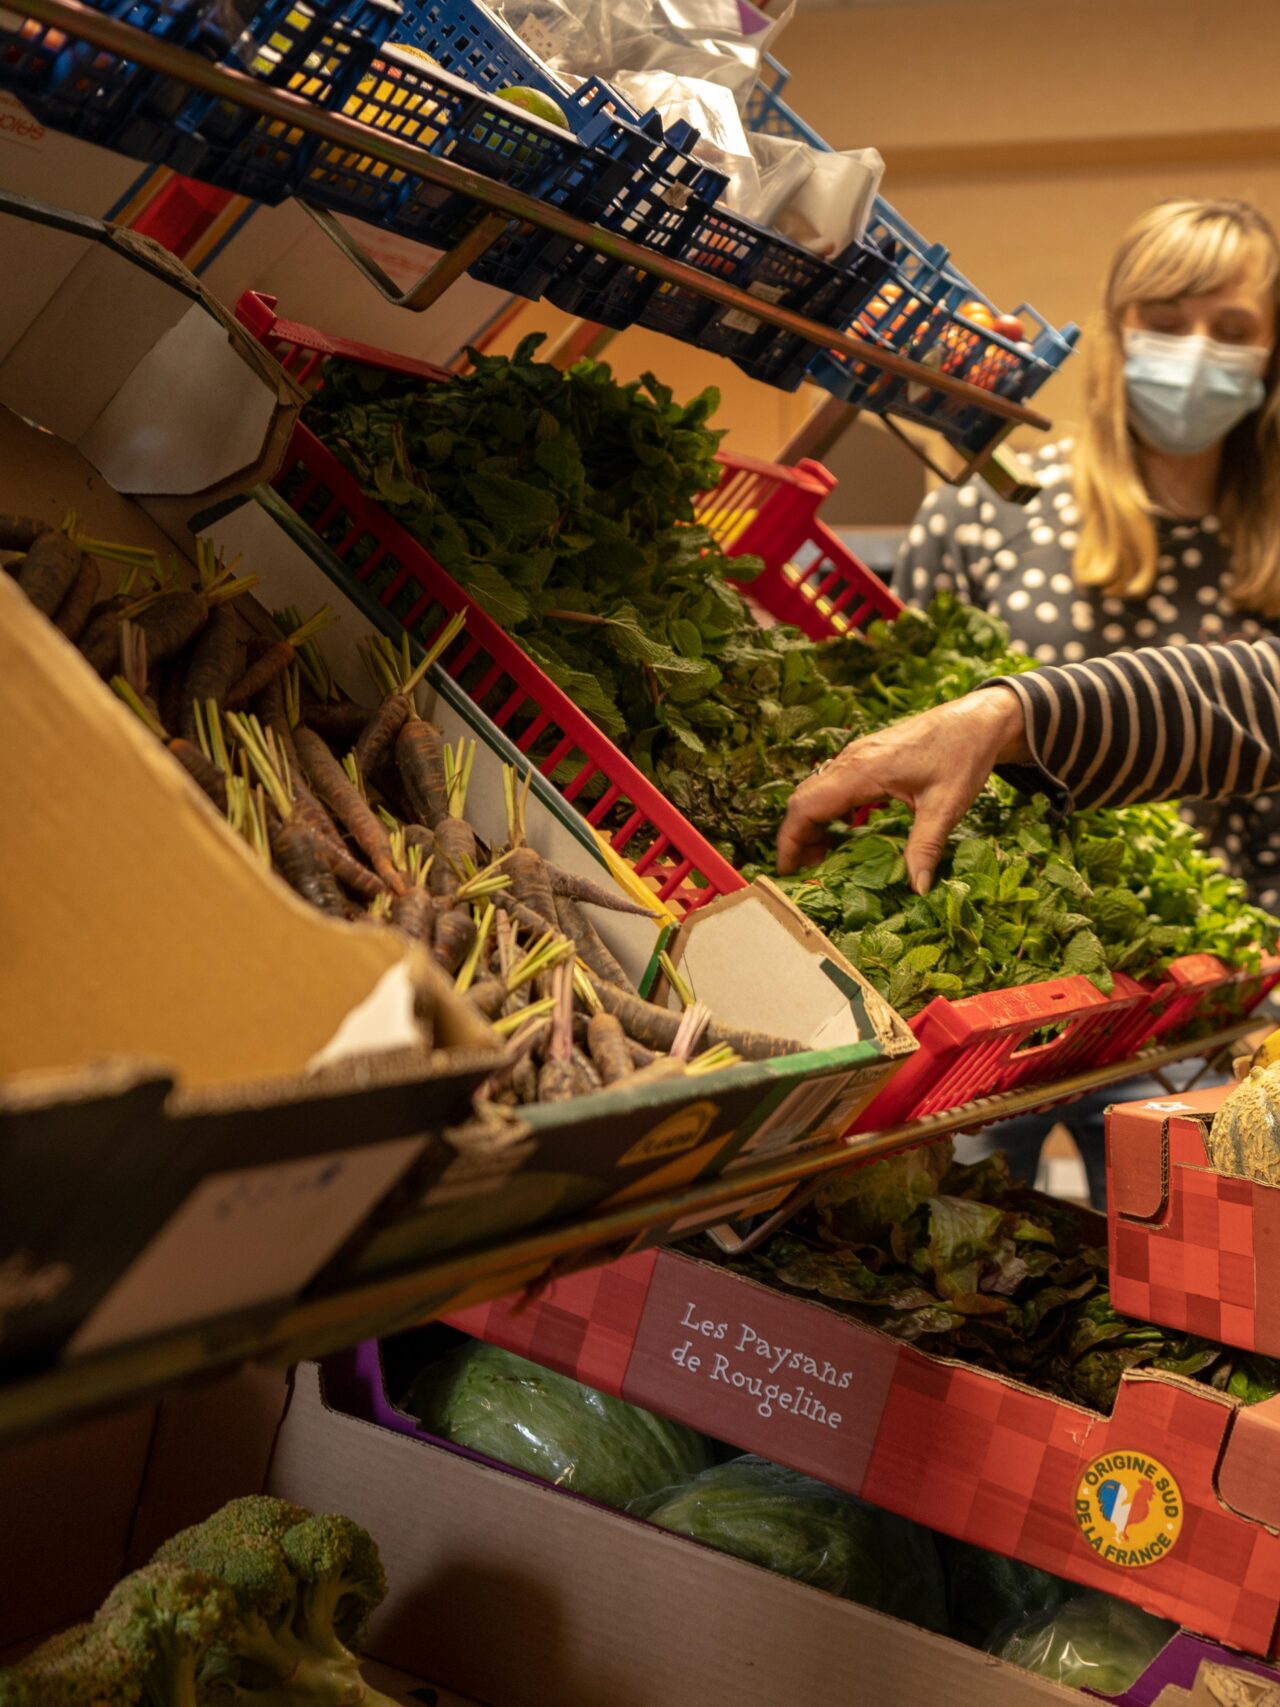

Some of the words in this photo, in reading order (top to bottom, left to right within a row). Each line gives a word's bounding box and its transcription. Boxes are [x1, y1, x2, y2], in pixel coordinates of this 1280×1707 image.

[680, 1302, 729, 1340] Les
[734, 1323, 854, 1389] Paysans
[671, 1341, 701, 1373] de
[709, 1353, 843, 1430] Rougeline
[1084, 1455, 1158, 1486] ORIGINE
[1155, 1477, 1179, 1518] SUD
[1076, 1499, 1093, 1525] DE
[1083, 1526, 1105, 1551] LA
[1104, 1532, 1172, 1566] FRANCE
